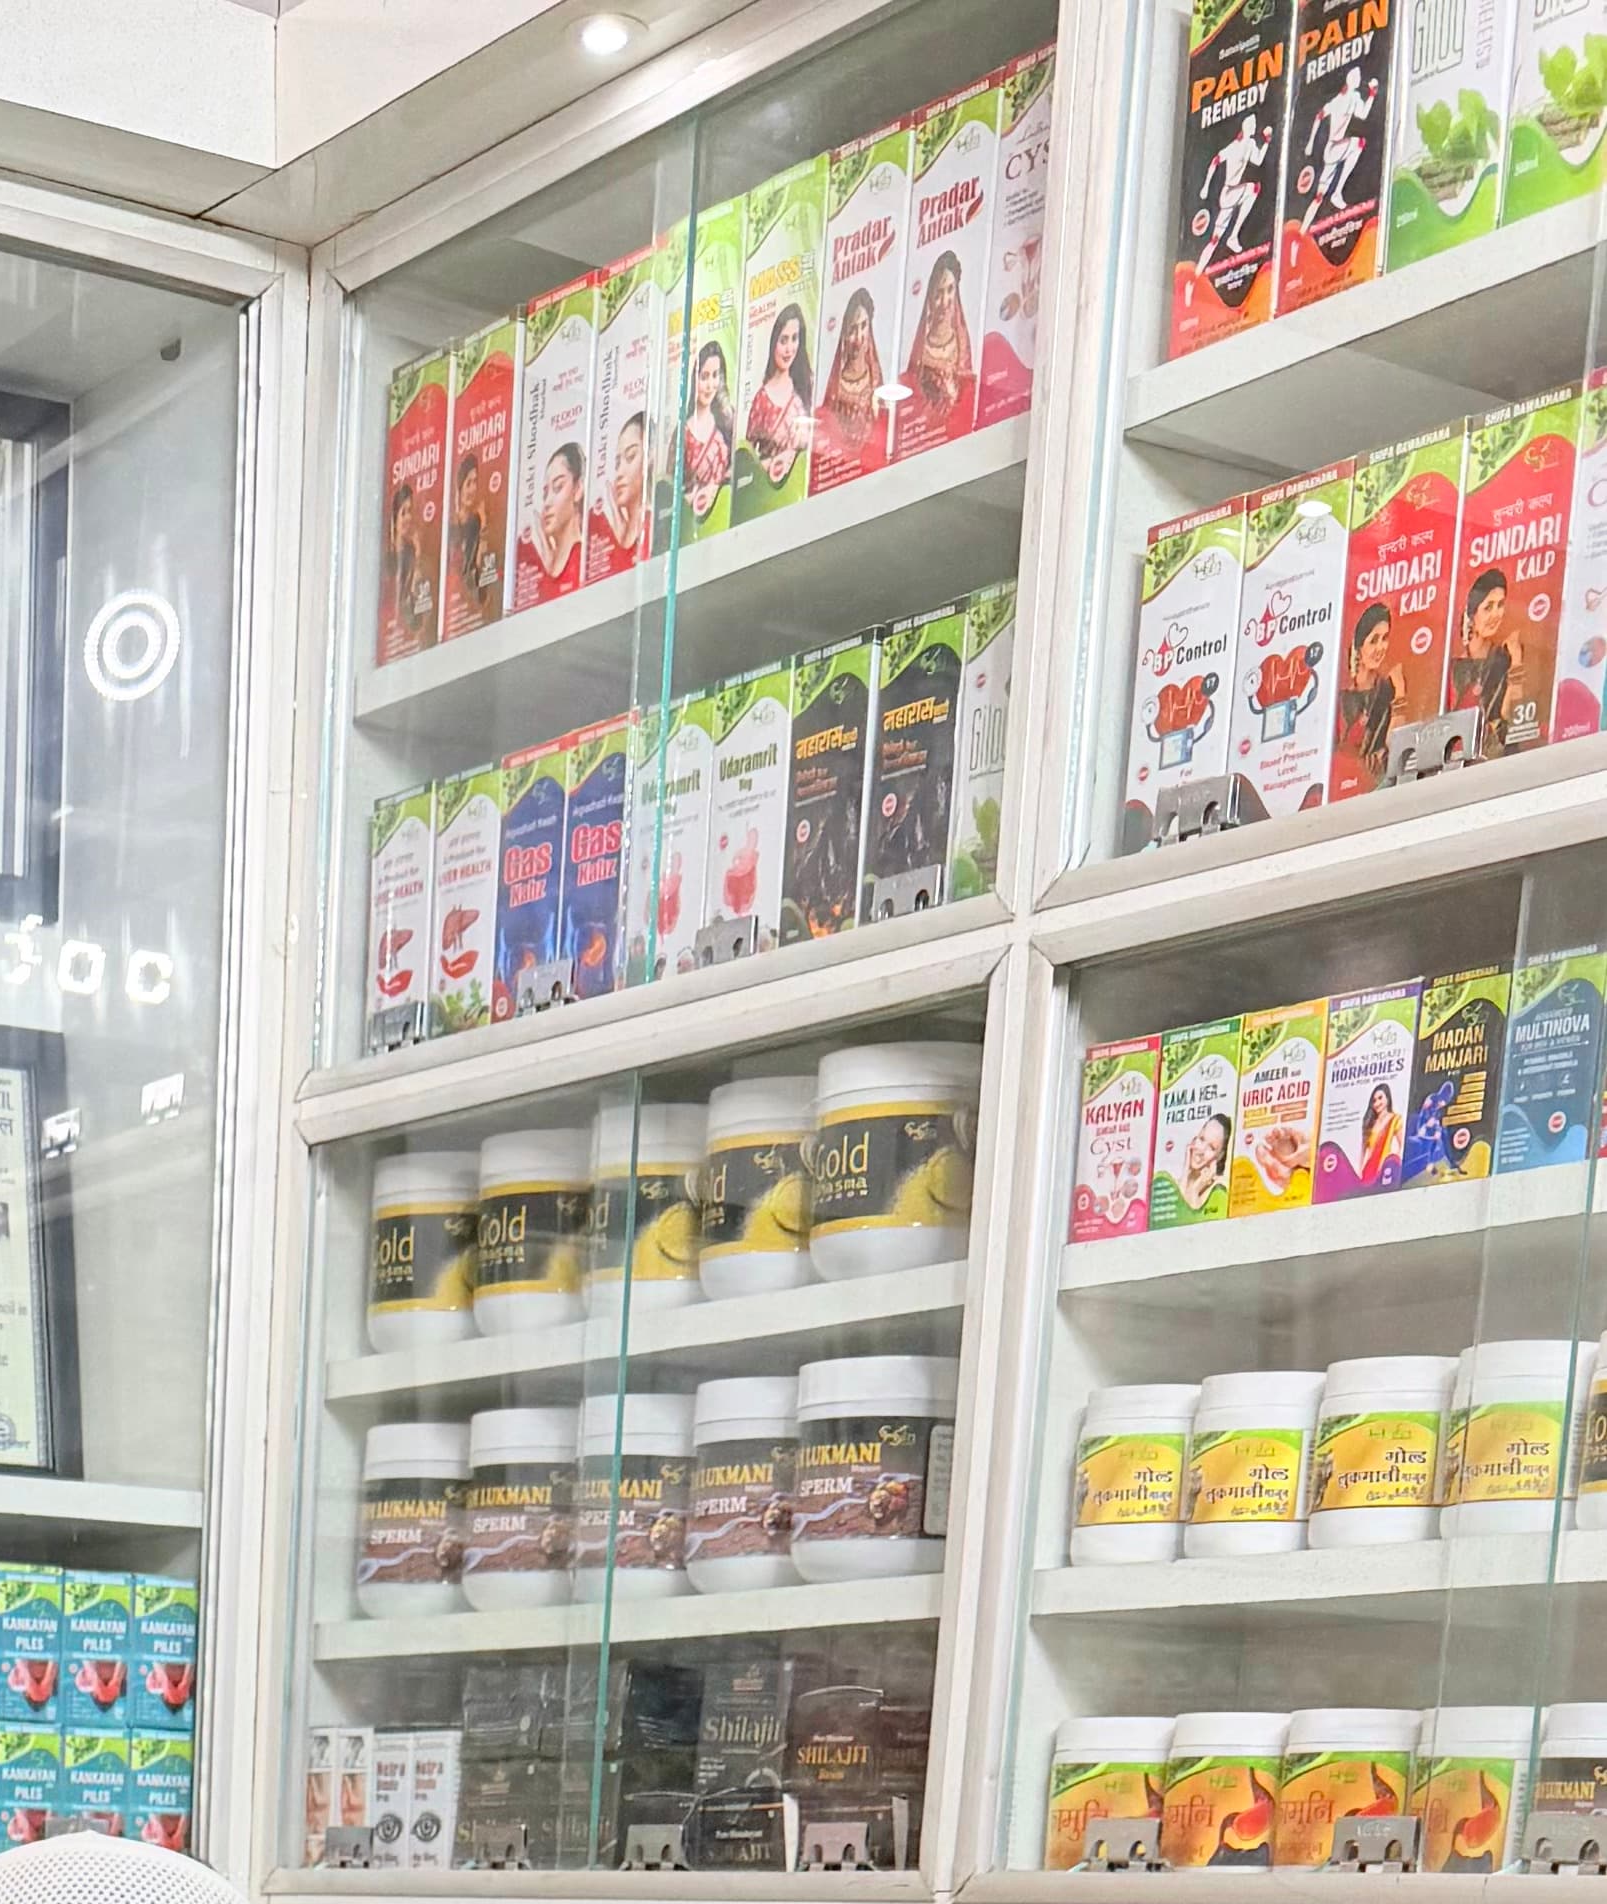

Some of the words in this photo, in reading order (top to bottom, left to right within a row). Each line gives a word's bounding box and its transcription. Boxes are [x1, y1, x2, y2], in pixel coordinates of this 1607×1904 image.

[1306, 31, 1375, 85] REMEDY
[1191, 42, 1283, 114] PAIN
[1201, 80, 1269, 129] REMEDY
[918, 175, 980, 226] Pradar
[833, 215, 892, 265] Pradar
[917, 206, 964, 249] Antak
[457, 411, 507, 453] SUNDARI
[392, 441, 441, 482] SUNDARI
[482, 441, 504, 464] KALP
[1469, 513, 1562, 567] SUNDARI
[1355, 549, 1443, 602] SUNDARI
[1516, 549, 1555, 583] KALP
[1399, 583, 1437, 617] KALP
[1279, 602, 1332, 635] Control
[1176, 634, 1227, 665] Control
[1512, 702, 1537, 724] 30
[719, 742, 778, 783] Udaramrit
[571, 820, 623, 864] Gas
[504, 841, 552, 886] Gas
[1432, 1022, 1485, 1049] MADAN
[1515, 1014, 1591, 1044] MULTINOVA
[1254, 1065, 1289, 1085] AMEER
[1331, 1058, 1405, 1084] HORMONES
[1425, 1045, 1489, 1073] MANJARI
[1242, 1083, 1273, 1107] URIC
[1276, 1079, 1310, 1102] ACID
[1085, 1098, 1145, 1129] KALYAN
[1089, 1133, 1133, 1157] Cyst
[800, 1475, 854, 1496] SPERM
[14, 1636, 45, 1652] PILES
[797, 1744, 870, 1766] SHILAJIT
